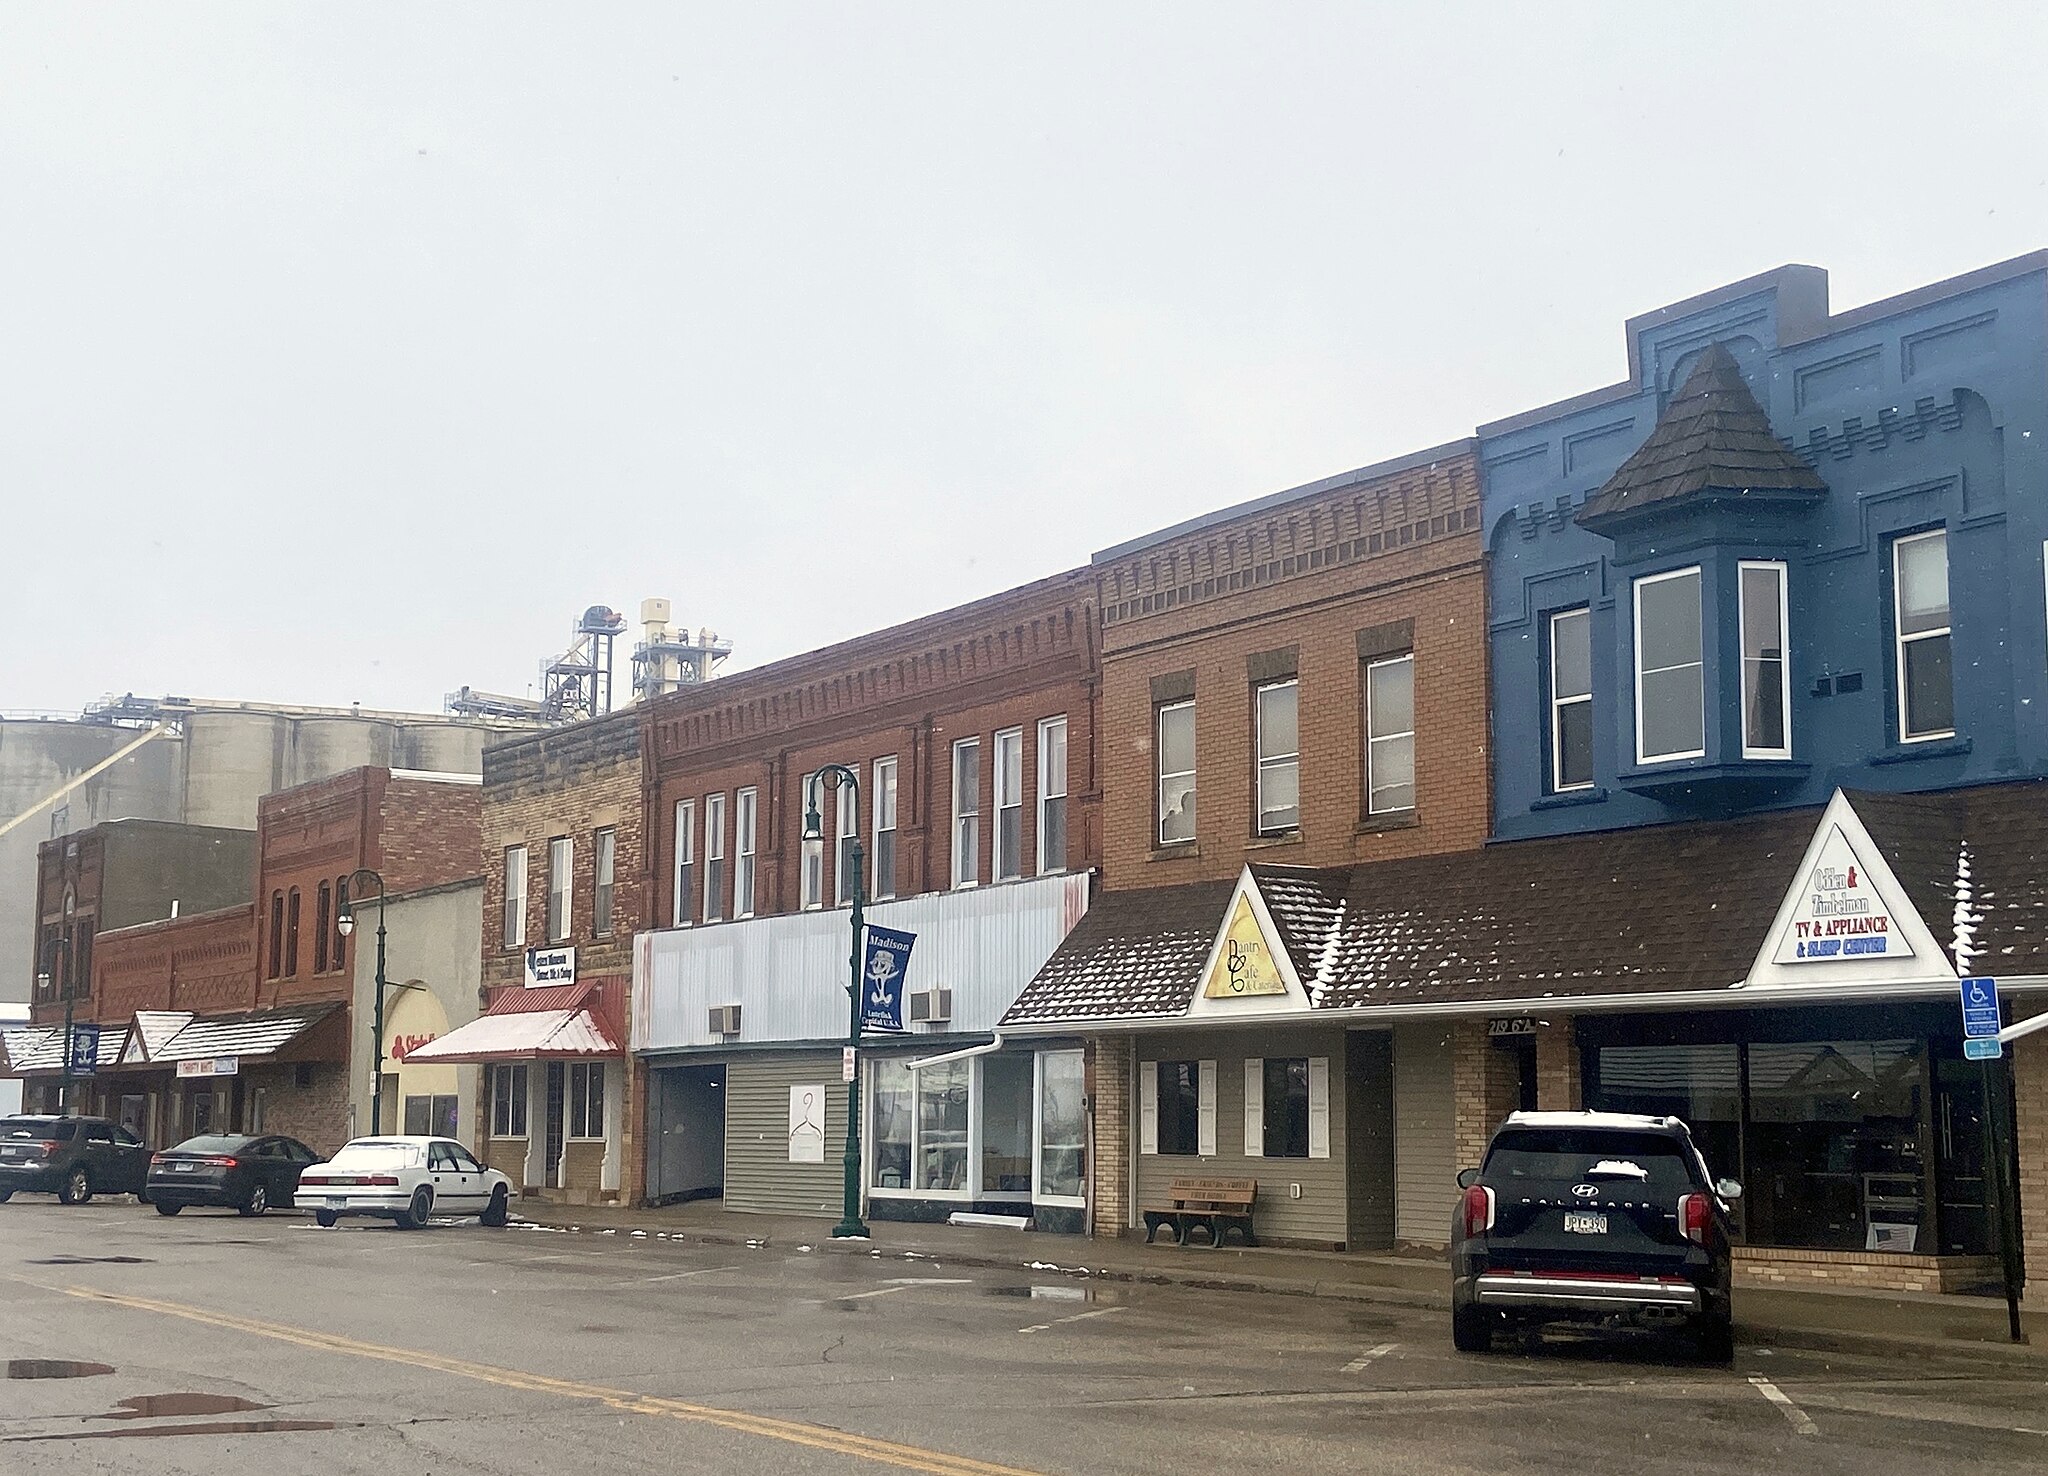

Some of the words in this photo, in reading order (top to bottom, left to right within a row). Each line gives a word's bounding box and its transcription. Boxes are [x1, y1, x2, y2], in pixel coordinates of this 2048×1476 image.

[1814, 867, 1846, 891] Odden
[1847, 866, 1858, 888] &
[1812, 892, 1869, 917] Zimbelman
[1795, 921, 1811, 938] TV
[1813, 920, 1822, 937] &
[1825, 916, 1888, 936] APPLIANCE
[869, 934, 910, 952] Madison
[1228, 939, 1260, 957] Pantry
[1796, 941, 1806, 958] &
[1807, 939, 1841, 957] SLEEP
[1843, 936, 1887, 955] CENTER
[1589, 1217, 1605, 1230] 390
